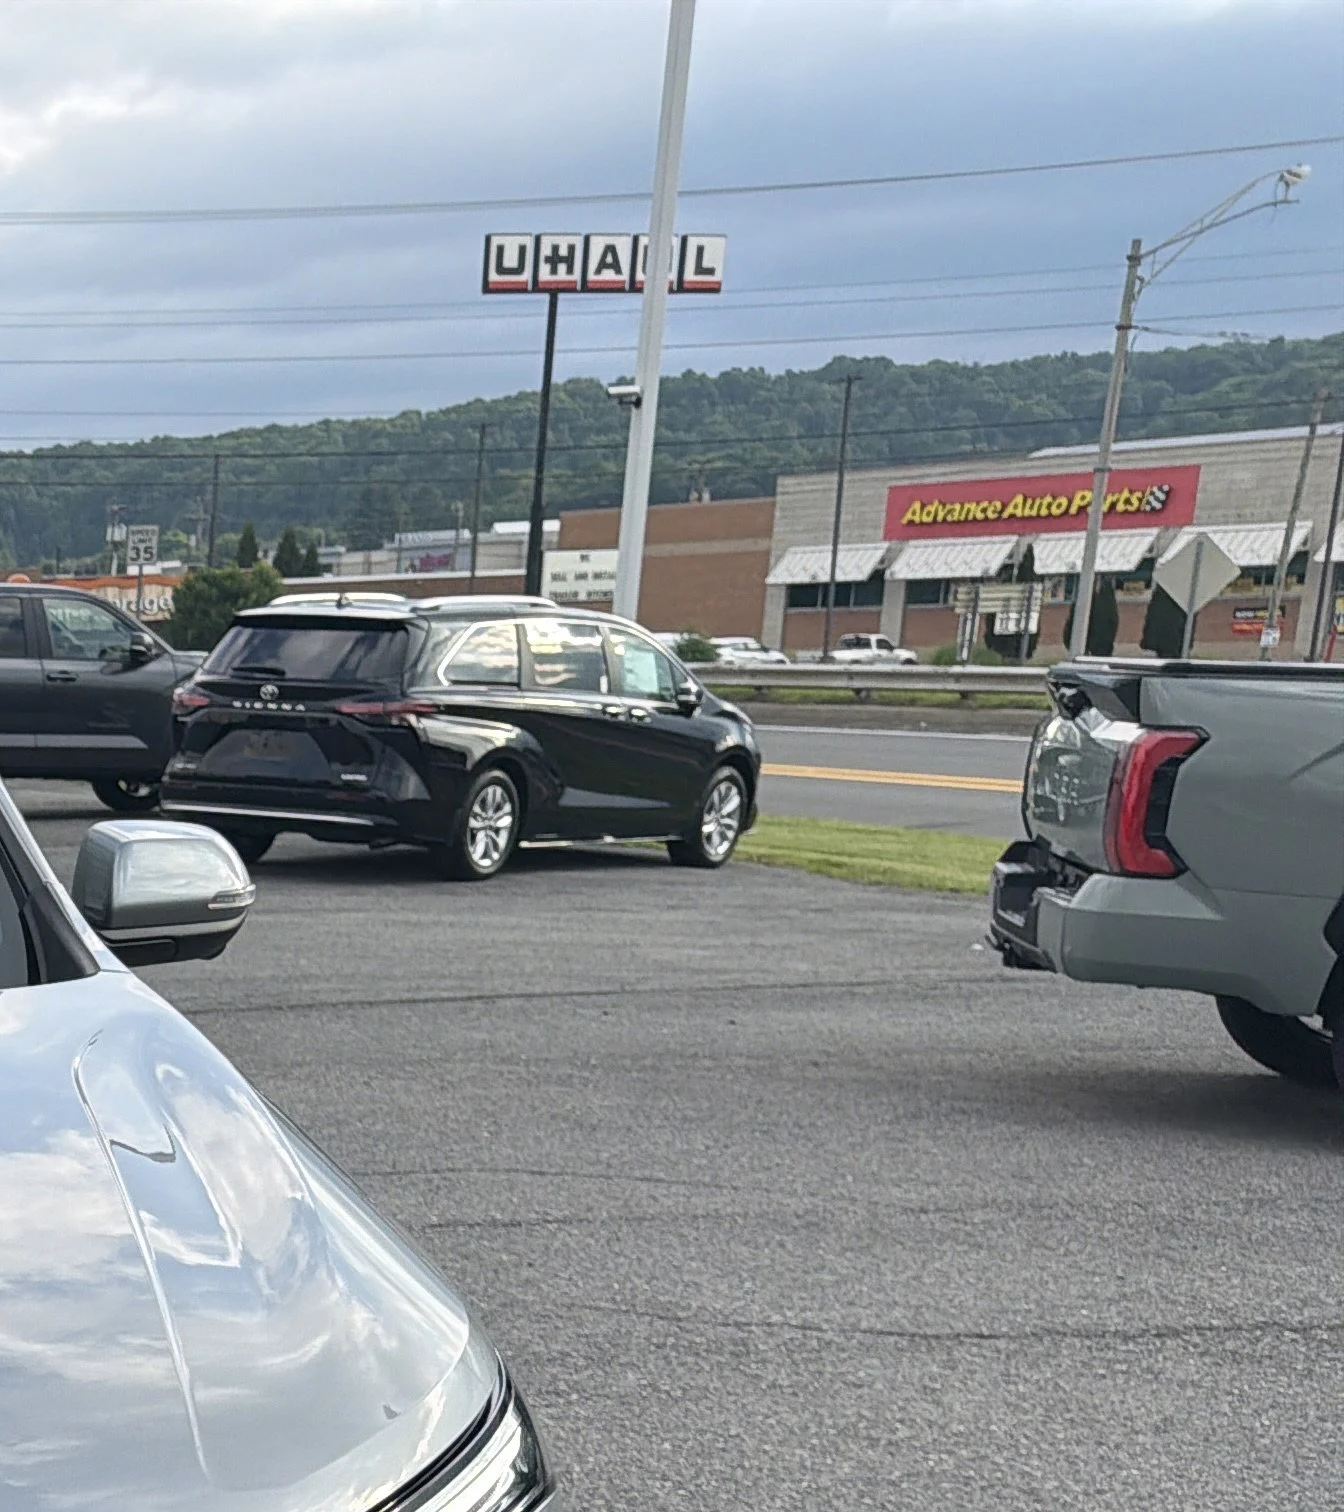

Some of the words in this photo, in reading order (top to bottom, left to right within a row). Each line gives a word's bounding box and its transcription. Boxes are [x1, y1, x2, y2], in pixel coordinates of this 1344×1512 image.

[901, 500, 1004, 525] Advance
[1002, 493, 1070, 519] Auto
[129, 545, 155, 561] 35
